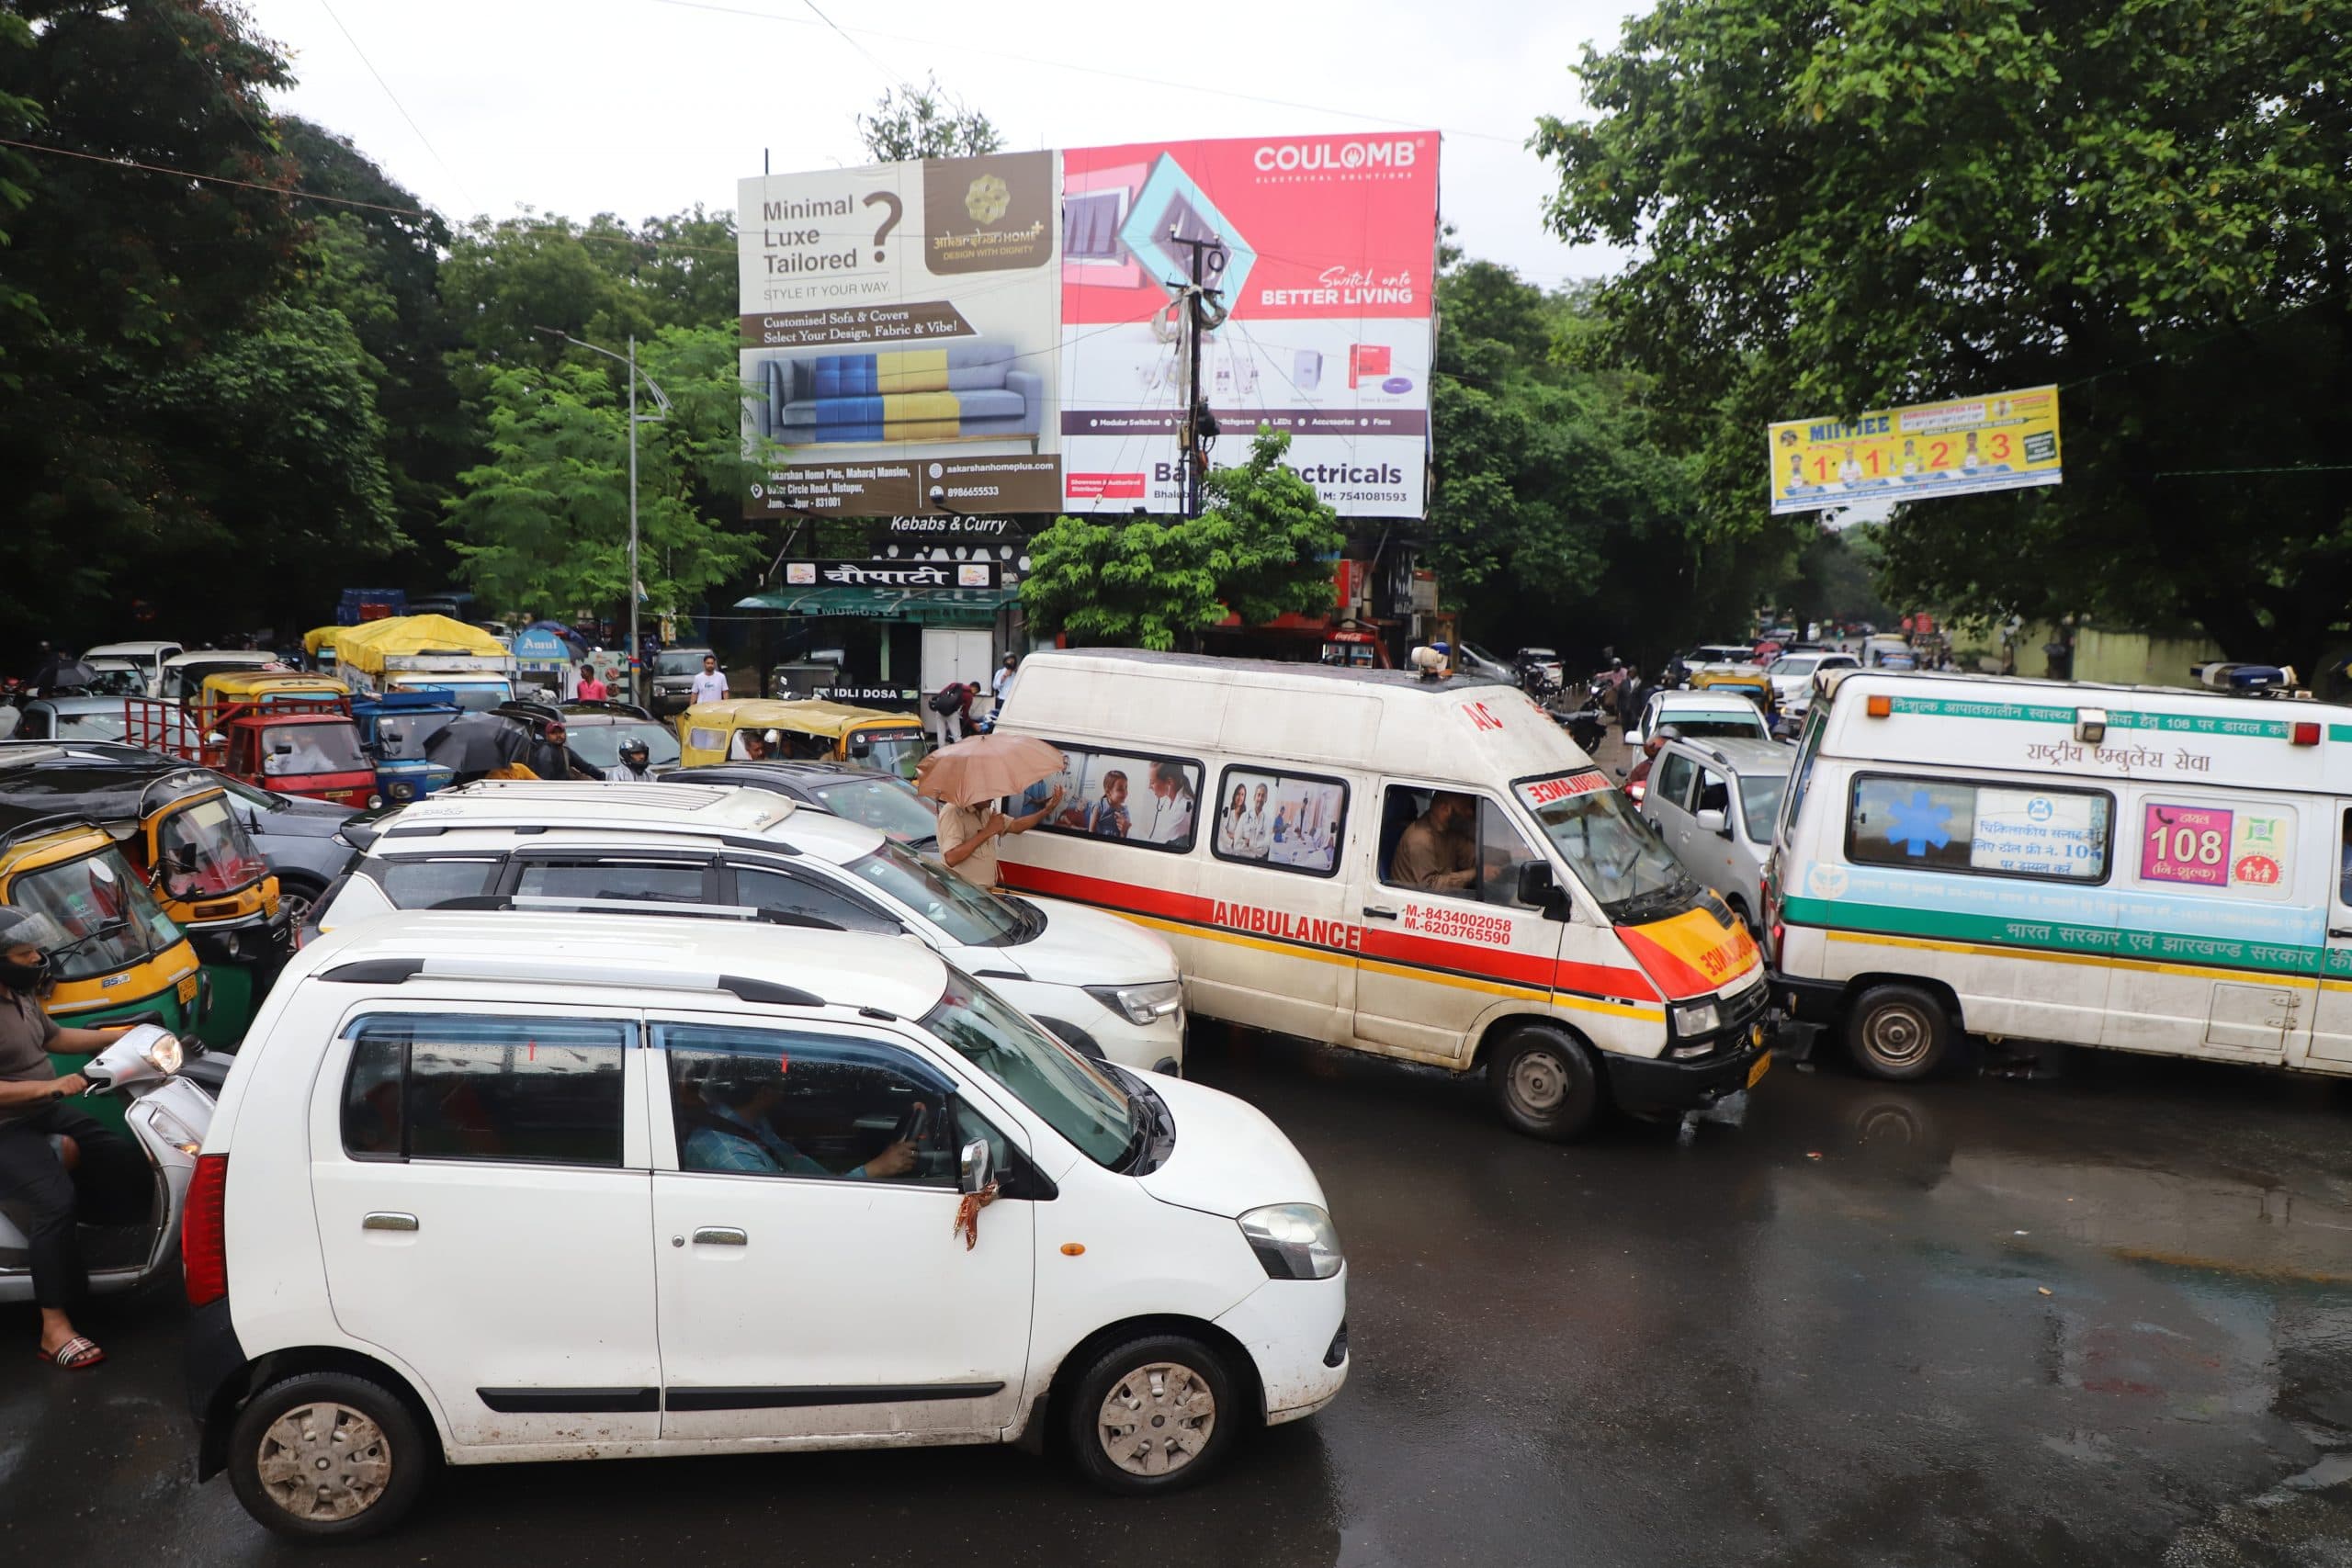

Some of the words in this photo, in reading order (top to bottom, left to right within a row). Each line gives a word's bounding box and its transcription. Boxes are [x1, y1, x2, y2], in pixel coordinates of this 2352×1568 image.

[1254, 141, 1415, 171] COULOMB
[763, 194, 853, 221] Minimal
[764, 229, 820, 248] Luxe
[763, 248, 857, 274] Tailored
[943, 251, 975, 261] DESIGN
[977, 248, 999, 258] WITH
[1000, 245, 1034, 255] DIGNITY
[1319, 265, 1374, 288] Switch
[763, 288, 802, 300] STYLE
[807, 287, 818, 298] IT
[821, 284, 857, 296] YOUR
[1261, 288, 1338, 305] BETTER
[1344, 288, 1413, 304] LIVING
[763, 312, 826, 328] Customised
[830, 312, 854, 324] Sofa
[857, 311, 866, 322] &
[870, 310, 909, 321] Covers
[763, 332, 797, 344] Select
[799, 331, 826, 342] Your
[875, 324, 910, 337] Fabric
[913, 323, 924, 334] &
[927, 321, 957, 333] Vibe!
[1100, 418, 1128, 427] Modular
[1129, 418, 1160, 427] Switches
[805, 468, 824, 479] Home
[846, 467, 876, 480] Maharaj
[946, 462, 1054, 474] aakarshanhomeplus.com
[787, 483, 808, 494] Circle
[947, 486, 1000, 498] 8986655533
[1340, 491, 1408, 502] 7541081593
[815, 497, 841, 508] 831001
[890, 515, 946, 531] Kebabs
[949, 515, 961, 531] &
[964, 515, 1008, 535] Curry
[823, 563, 950, 585] चौपाटी
[522, 637, 558, 649] Amul
[834, 688, 859, 698] IDLI
[863, 689, 898, 699] DOSA
[2166, 718, 2190, 729] 108
[2198, 719, 2215, 731] पर
[2222, 720, 2261, 735] डायल
[2027, 740, 2084, 765] राष्ट्रीय
[2175, 748, 2211, 772] सेवा
[2151, 826, 2222, 865] 108
[1214, 901, 1360, 951] AMBULANCE
[1406, 904, 1512, 932] M.-8434002058
[1404, 917, 1510, 945] M.-6203765590
[2007, 922, 2052, 942] भारत
[2058, 926, 2120, 947] सरकार
[2128, 931, 2154, 951] एवं
[2162, 936, 2243, 956] झारखण्ड
[2249, 945, 2316, 967] सरकार
